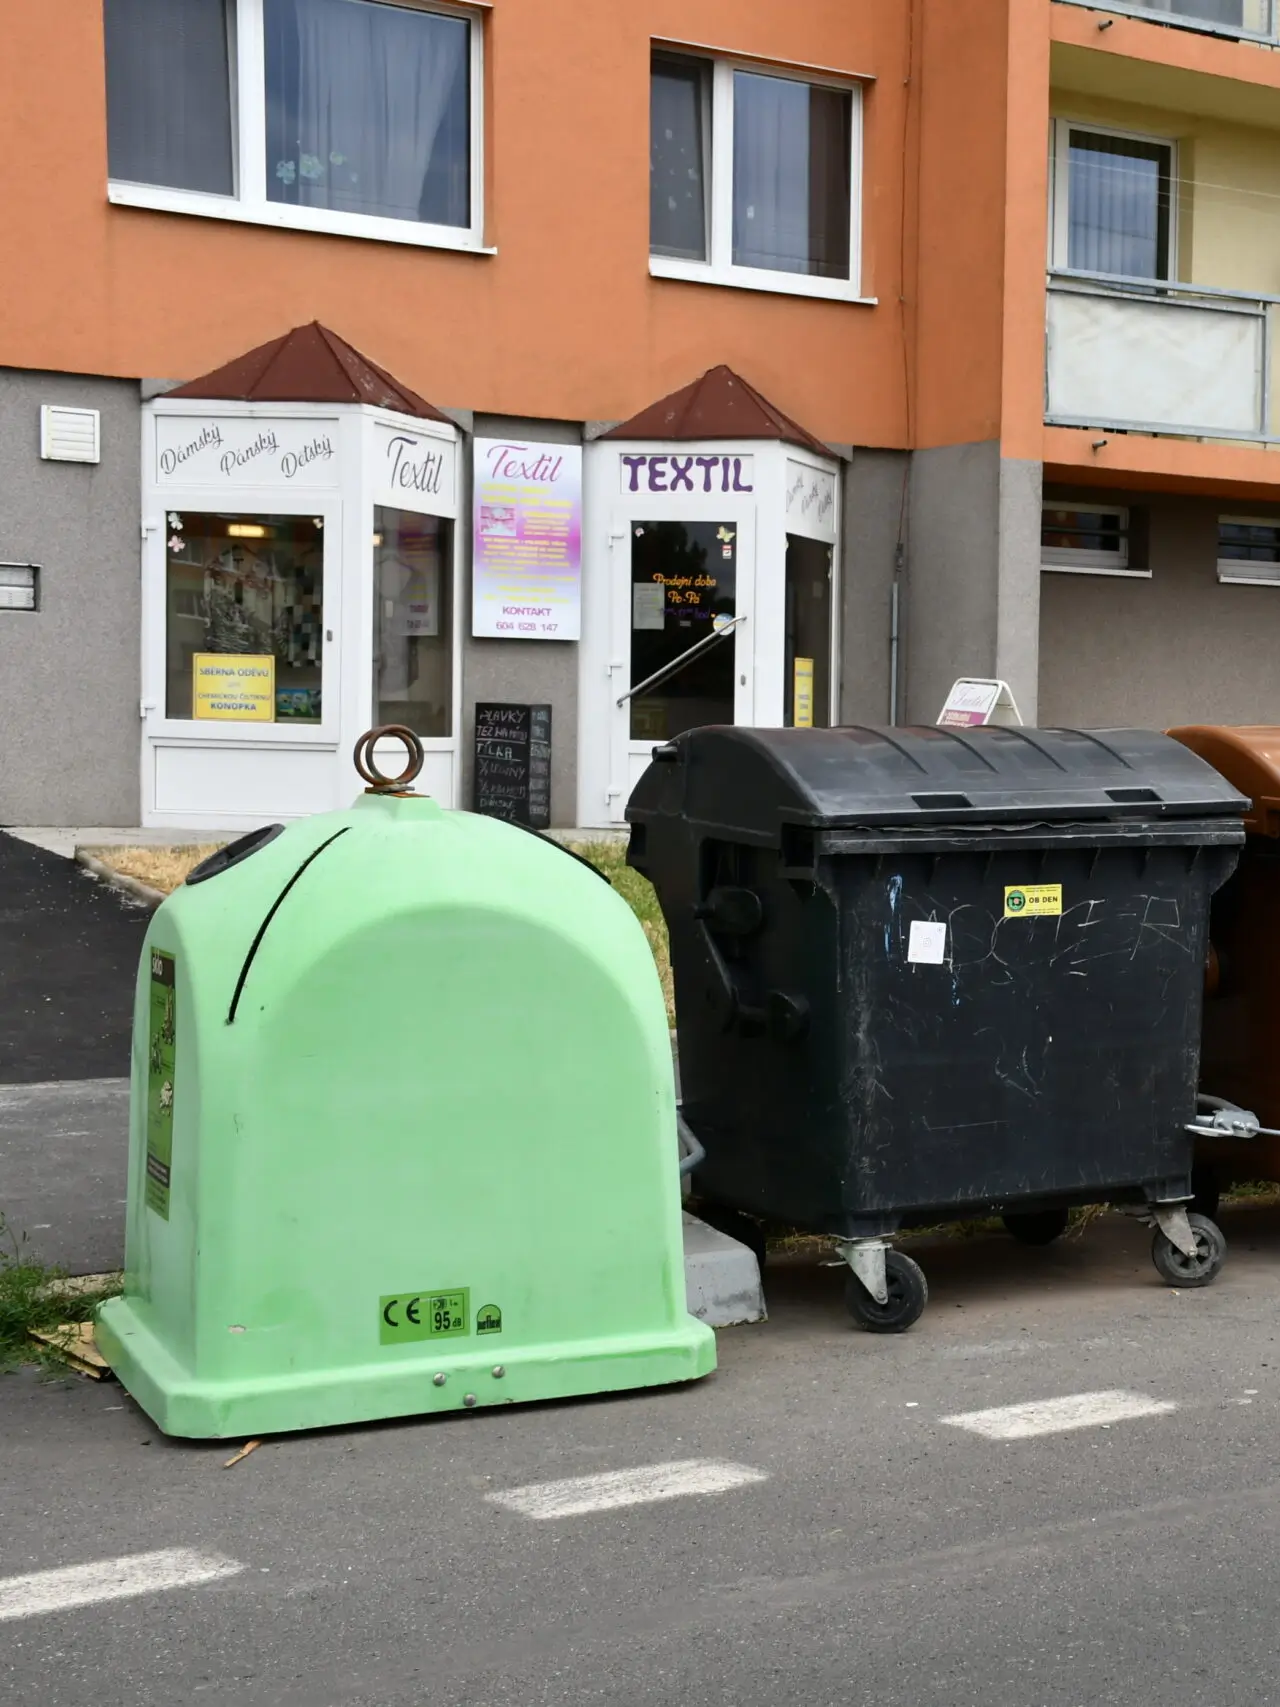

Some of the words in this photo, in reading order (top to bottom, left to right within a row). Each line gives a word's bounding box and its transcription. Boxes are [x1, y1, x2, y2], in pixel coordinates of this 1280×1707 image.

[160, 421, 225, 475] Dámský
[220, 428, 280, 477] Pánský
[486, 444, 563, 482] Textil
[387, 436, 443, 495] Textil
[622, 456, 753, 493] TEXTIL
[502, 606, 552, 617] KONTAKT
[210, 702, 257, 711] KONOPKA
[1028, 896, 1040, 904] OB
[1042, 896, 1058, 904] DEN
[383, 1297, 421, 1327] CE
[434, 1311, 451, 1330] 95
[452, 1317, 462, 1328] dB
